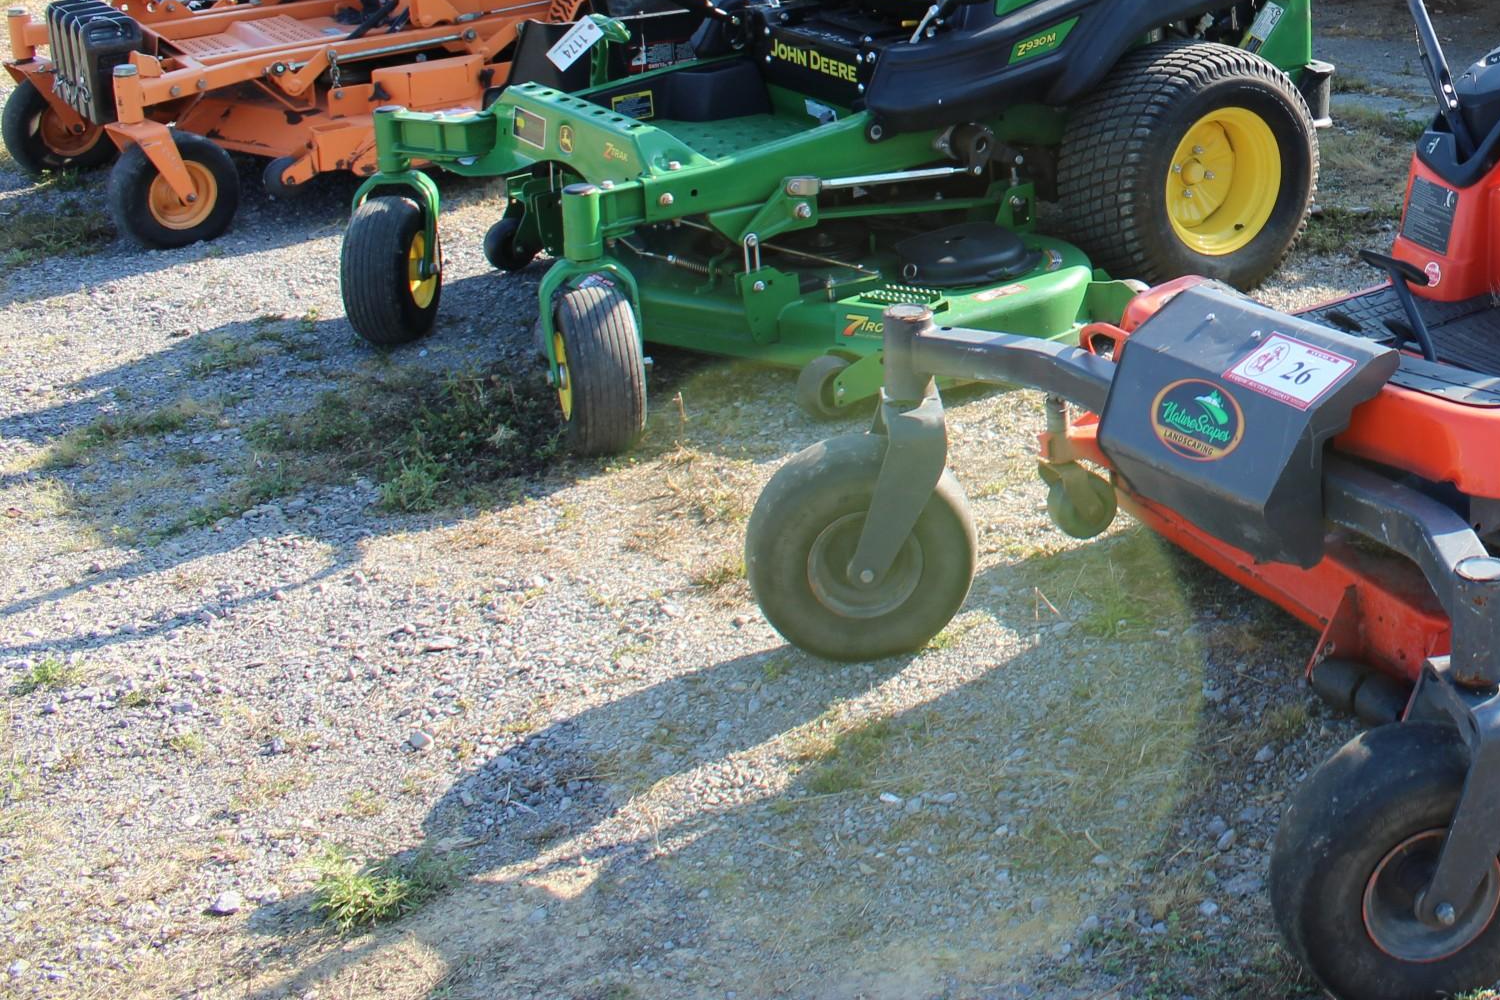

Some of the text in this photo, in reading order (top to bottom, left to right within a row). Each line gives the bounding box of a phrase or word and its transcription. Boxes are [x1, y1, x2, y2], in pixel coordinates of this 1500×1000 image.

[1017, 32, 1056, 56] Z930M
[771, 38, 857, 83] JOHN DEERE
[842, 314, 884, 336] 7IRO
[1280, 361, 1320, 385] 26
[1162, 401, 1231, 444] NatureScapes
[1163, 429, 1214, 456] LANDSCAPING
